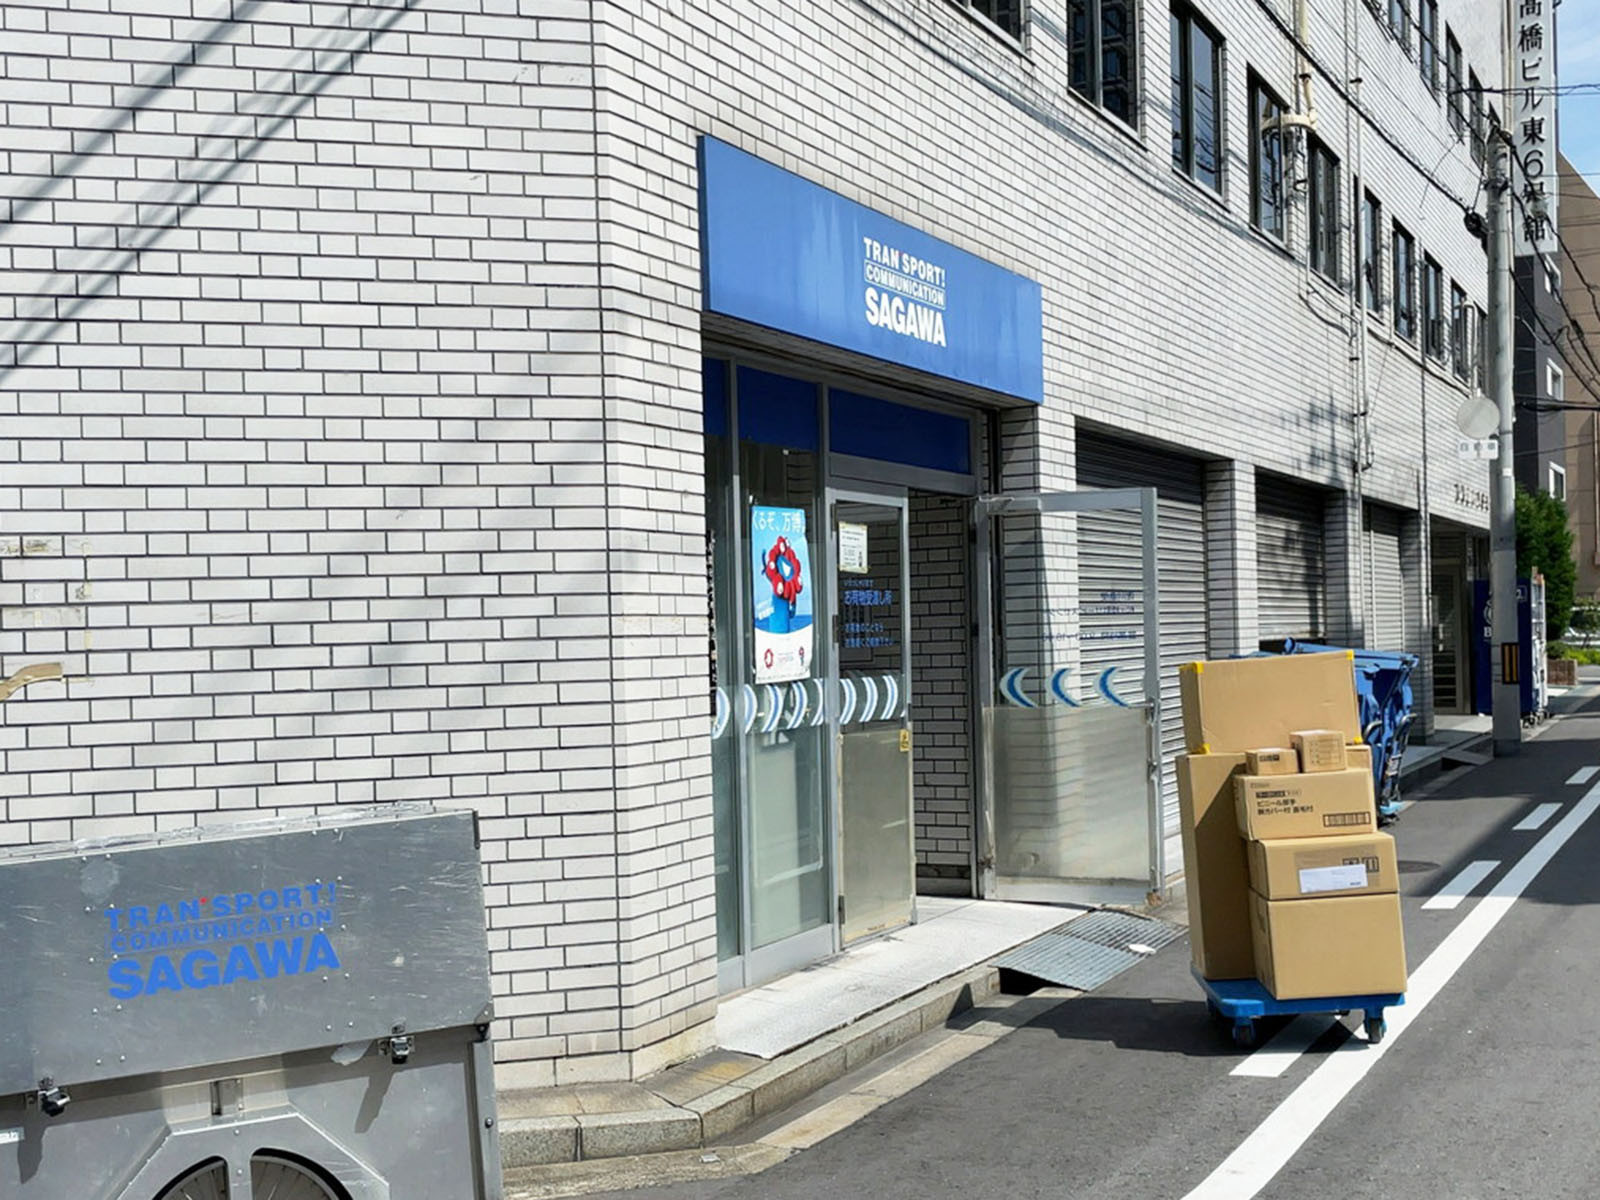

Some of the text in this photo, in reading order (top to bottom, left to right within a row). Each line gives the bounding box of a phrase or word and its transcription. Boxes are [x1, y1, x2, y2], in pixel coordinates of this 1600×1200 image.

[865, 263, 945, 307] COMMUNICATION
[865, 287, 946, 347] SAGAWA
[109, 908, 333, 952] COMMUNICATION
[108, 933, 341, 1000] SAGAWA
